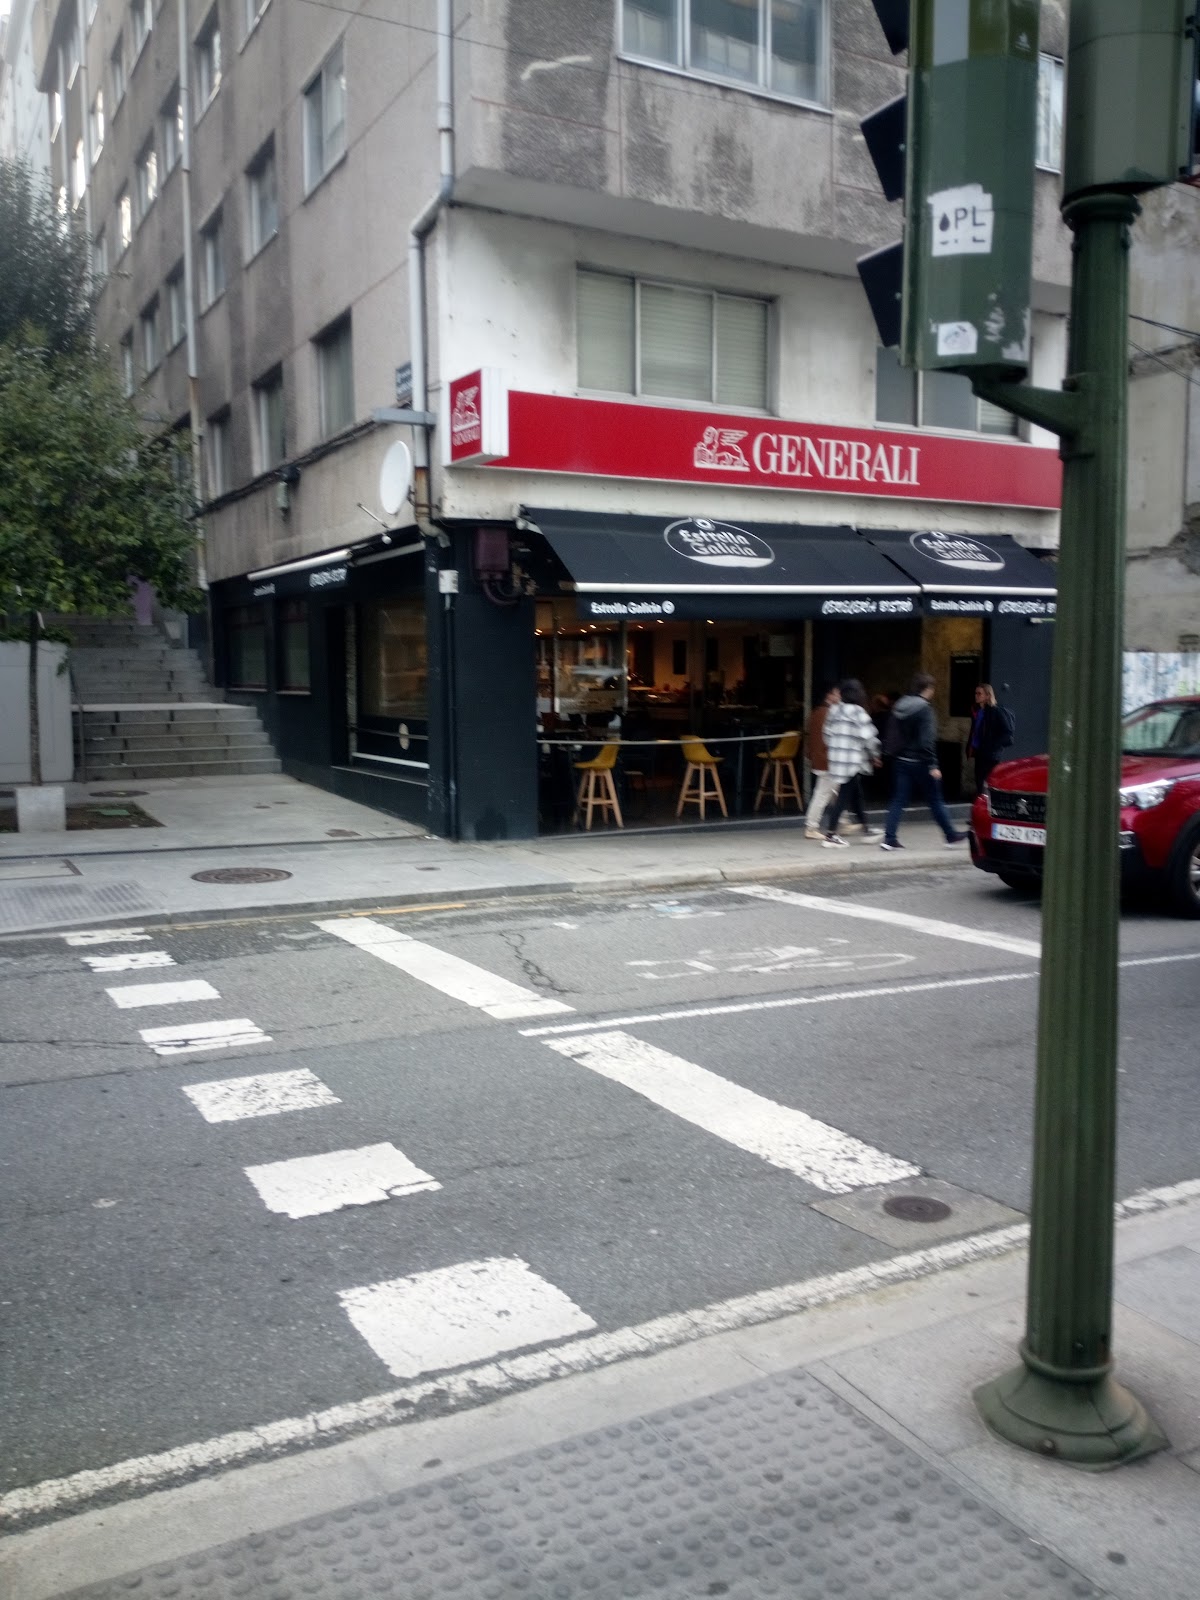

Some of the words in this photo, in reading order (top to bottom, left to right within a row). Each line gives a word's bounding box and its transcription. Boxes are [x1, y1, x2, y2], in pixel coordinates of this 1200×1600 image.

[752, 431, 921, 486] GENERALI
[678, 529, 751, 545] Estrella
[921, 538, 982, 552] Estrella
[690, 541, 758, 557] Galicia
[934, 549, 992, 562] Galicia
